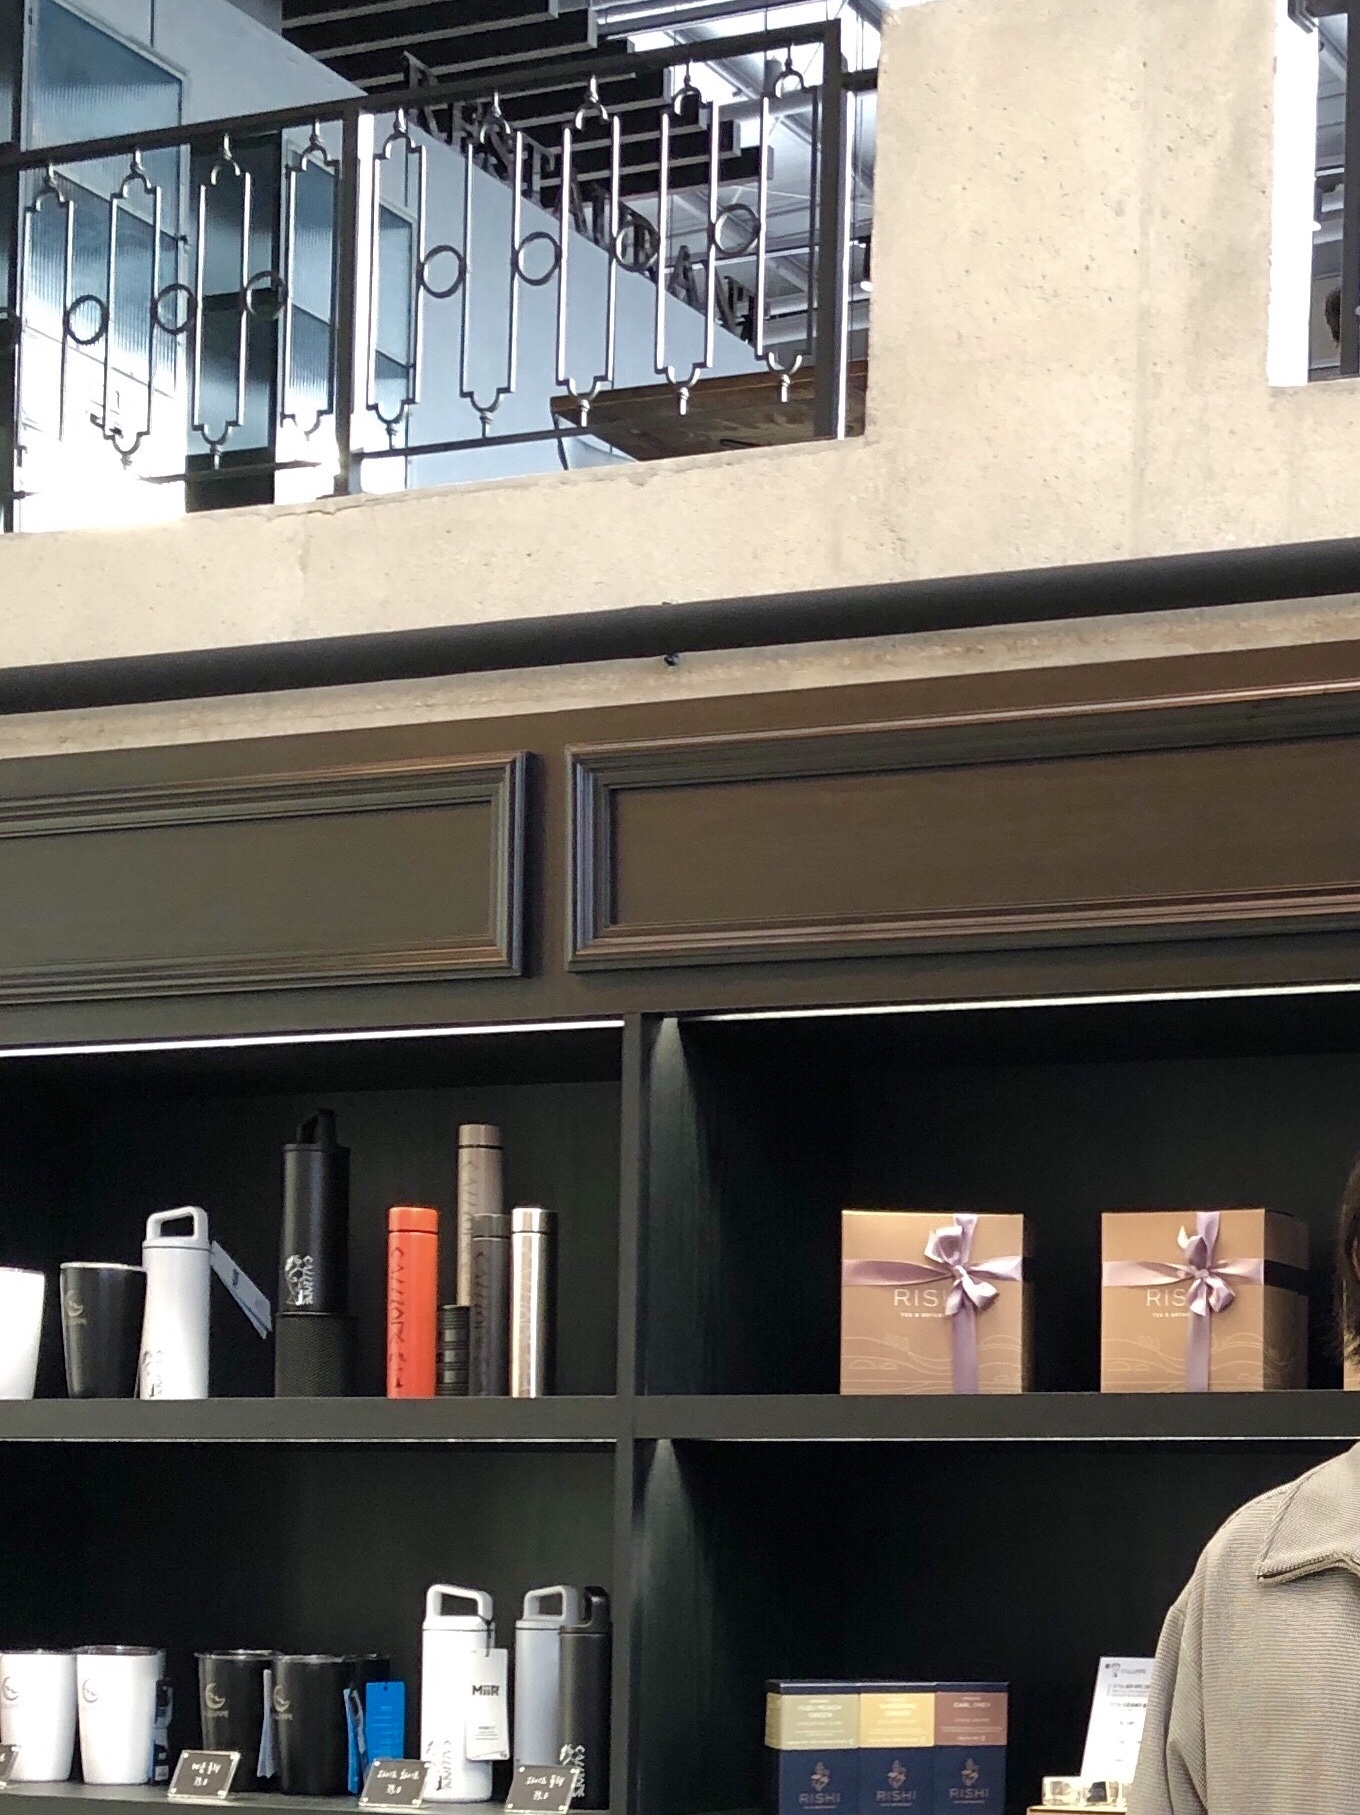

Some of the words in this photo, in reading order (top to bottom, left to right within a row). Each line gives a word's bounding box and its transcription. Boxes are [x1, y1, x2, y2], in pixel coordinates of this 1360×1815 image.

[893, 1288, 946, 1307] RIS
[1146, 1288, 1187, 1307] RIS
[799, 1792, 841, 1804] RISHI
[876, 1790, 917, 1802] RISHI
[949, 1787, 989, 1799] RISHI
